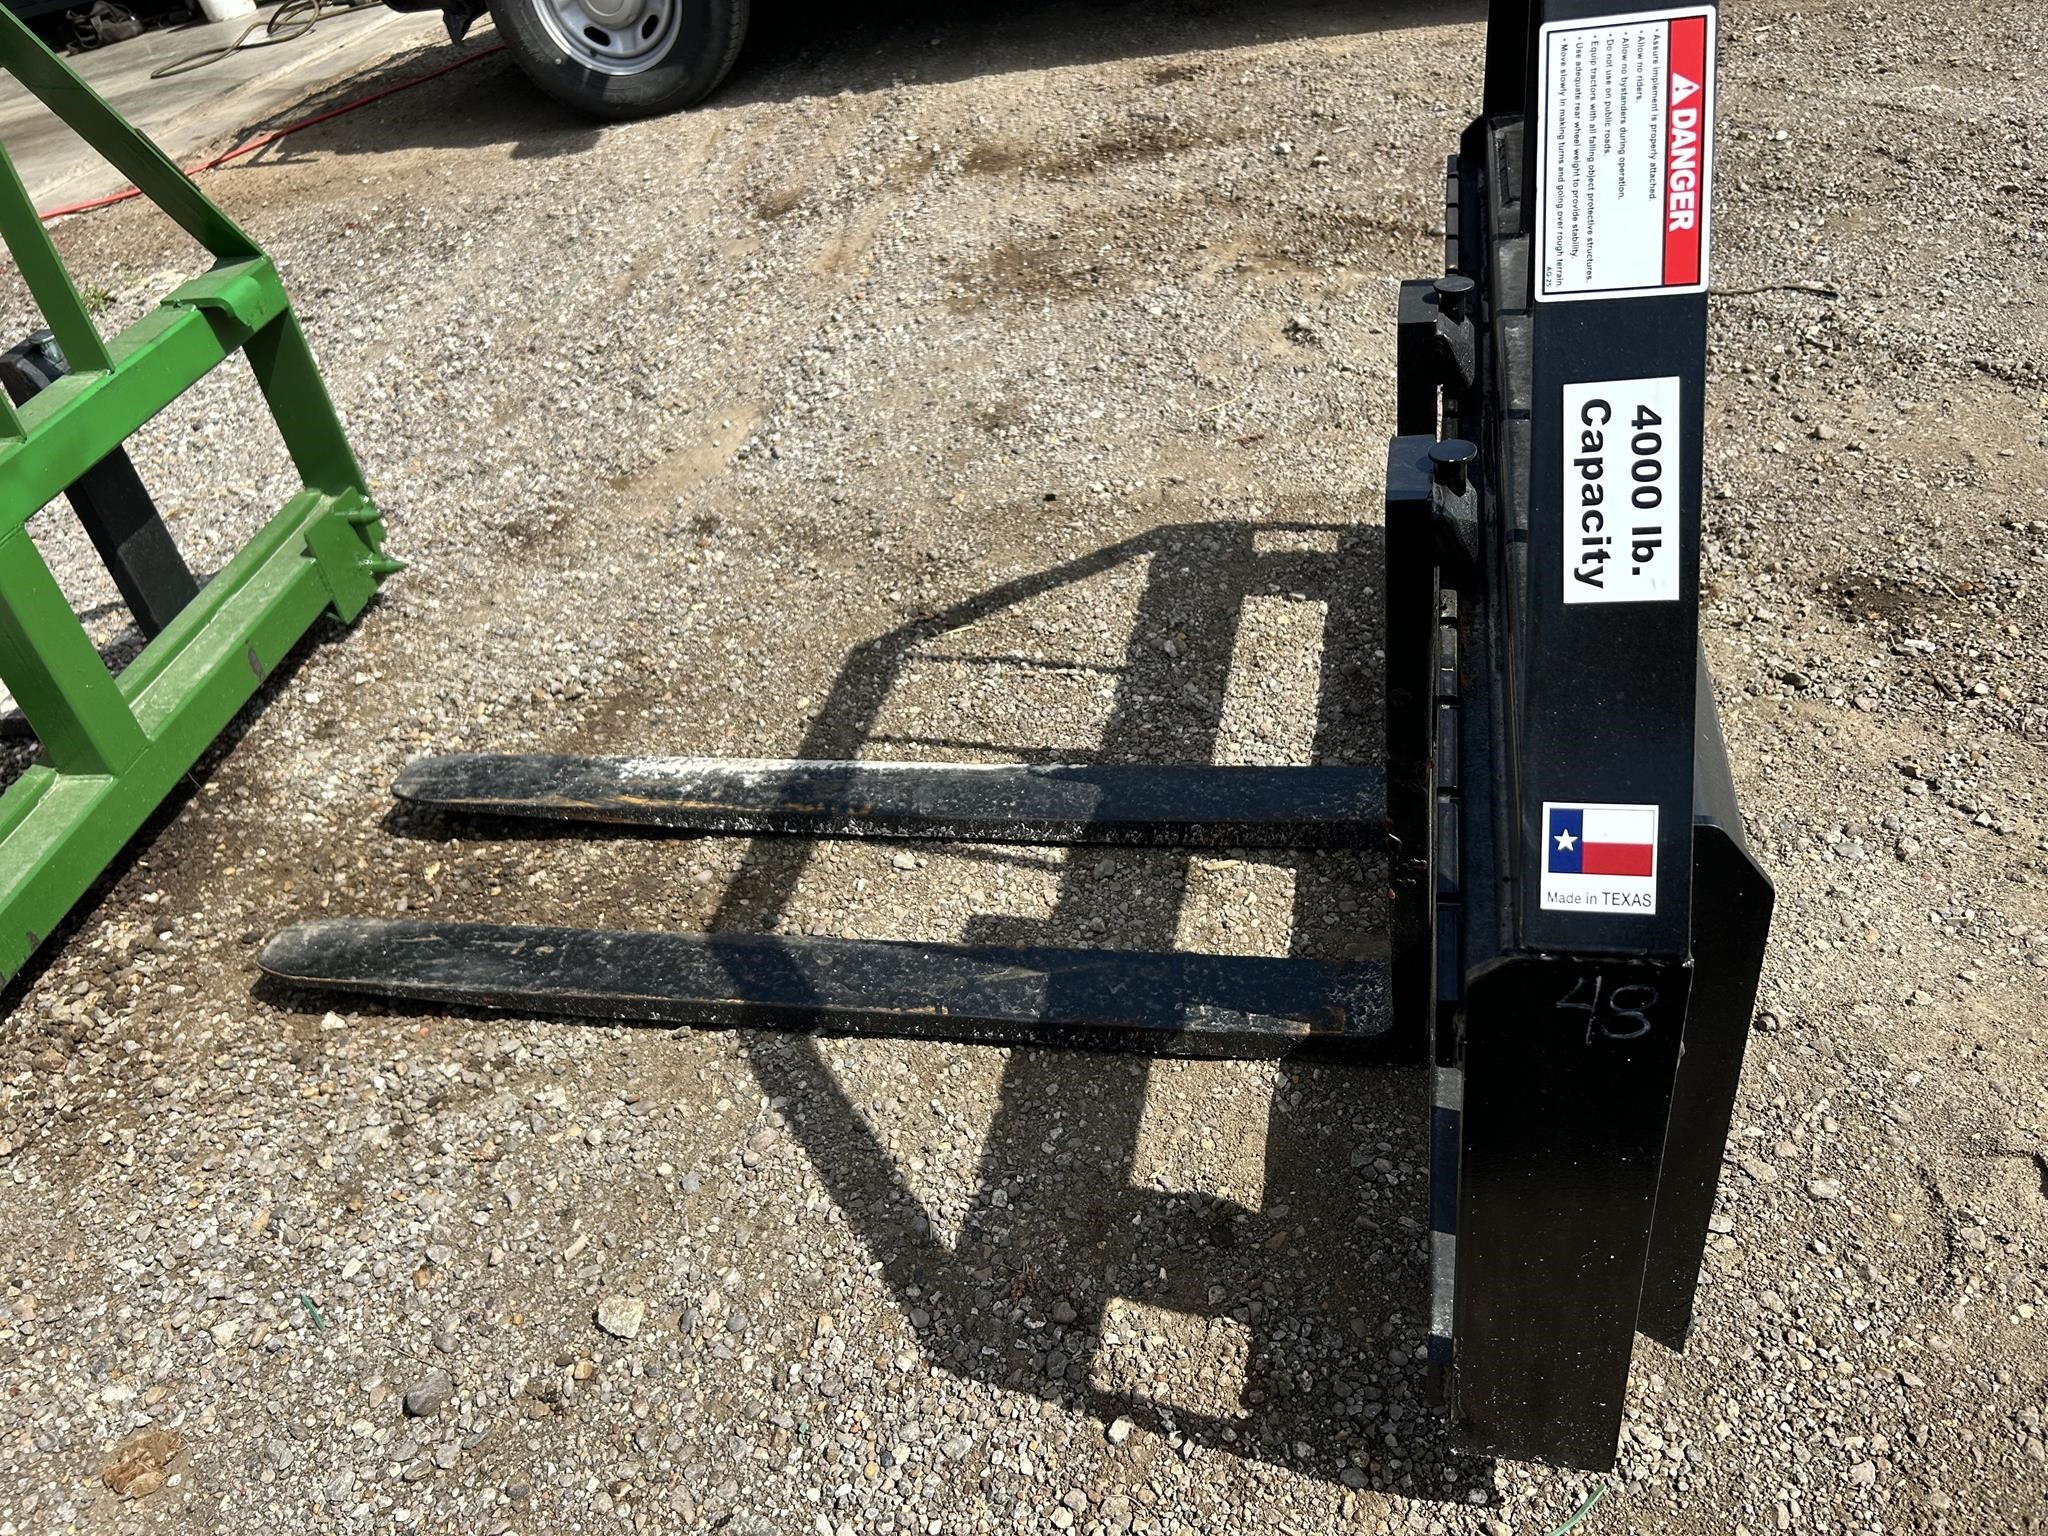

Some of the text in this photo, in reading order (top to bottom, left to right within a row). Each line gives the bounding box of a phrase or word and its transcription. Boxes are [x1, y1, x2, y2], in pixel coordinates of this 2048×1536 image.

[1560, 44, 1568, 67] Move
[1589, 40, 1599, 65] Equip
[1606, 39, 1615, 51] Do
[1652, 34, 1661, 64] Assure
[1558, 69, 1567, 96] slowly
[1574, 61, 1583, 100] adequate
[1636, 36, 1645, 102] Allow no riders.
[1605, 88, 1611, 99] on
[1651, 67, 1659, 112] implement
[1556, 109, 1566, 140] making
[1589, 103, 1597, 121] with
[1604, 101, 1613, 127] public
[1617, 37, 1630, 200] Allow no bystanders during operation.
[1574, 121, 1582, 146] wheel
[1589, 124, 1597, 134] all
[1604, 130, 1612, 155] roads.
[1648, 124, 1658, 160] properly
[1558, 142, 1566, 164] turns
[1571, 148, 1581, 177] weight
[1586, 135, 1597, 162] falling
[1573, 178, 1580, 188] to
[1586, 164, 1596, 191] object
[1649, 162, 1657, 201] attached.
[1669, 108, 1697, 232] DANGER
[1555, 184, 1565, 209] going
[1571, 190, 1580, 221] provide
[1586, 193, 1595, 235] protective
[1555, 231, 1564, 257] rough
[1569, 224, 1579, 258] stability.
[1556, 259, 1564, 288] terrain.
[1586, 237, 1594, 283] structures.
[1573, 398, 1612, 589] Capacity
[1631, 404, 1662, 575] 4000 lb.
[1547, 891, 1652, 907] Made in TEXAS
[1556, 976, 1659, 1045] 48
